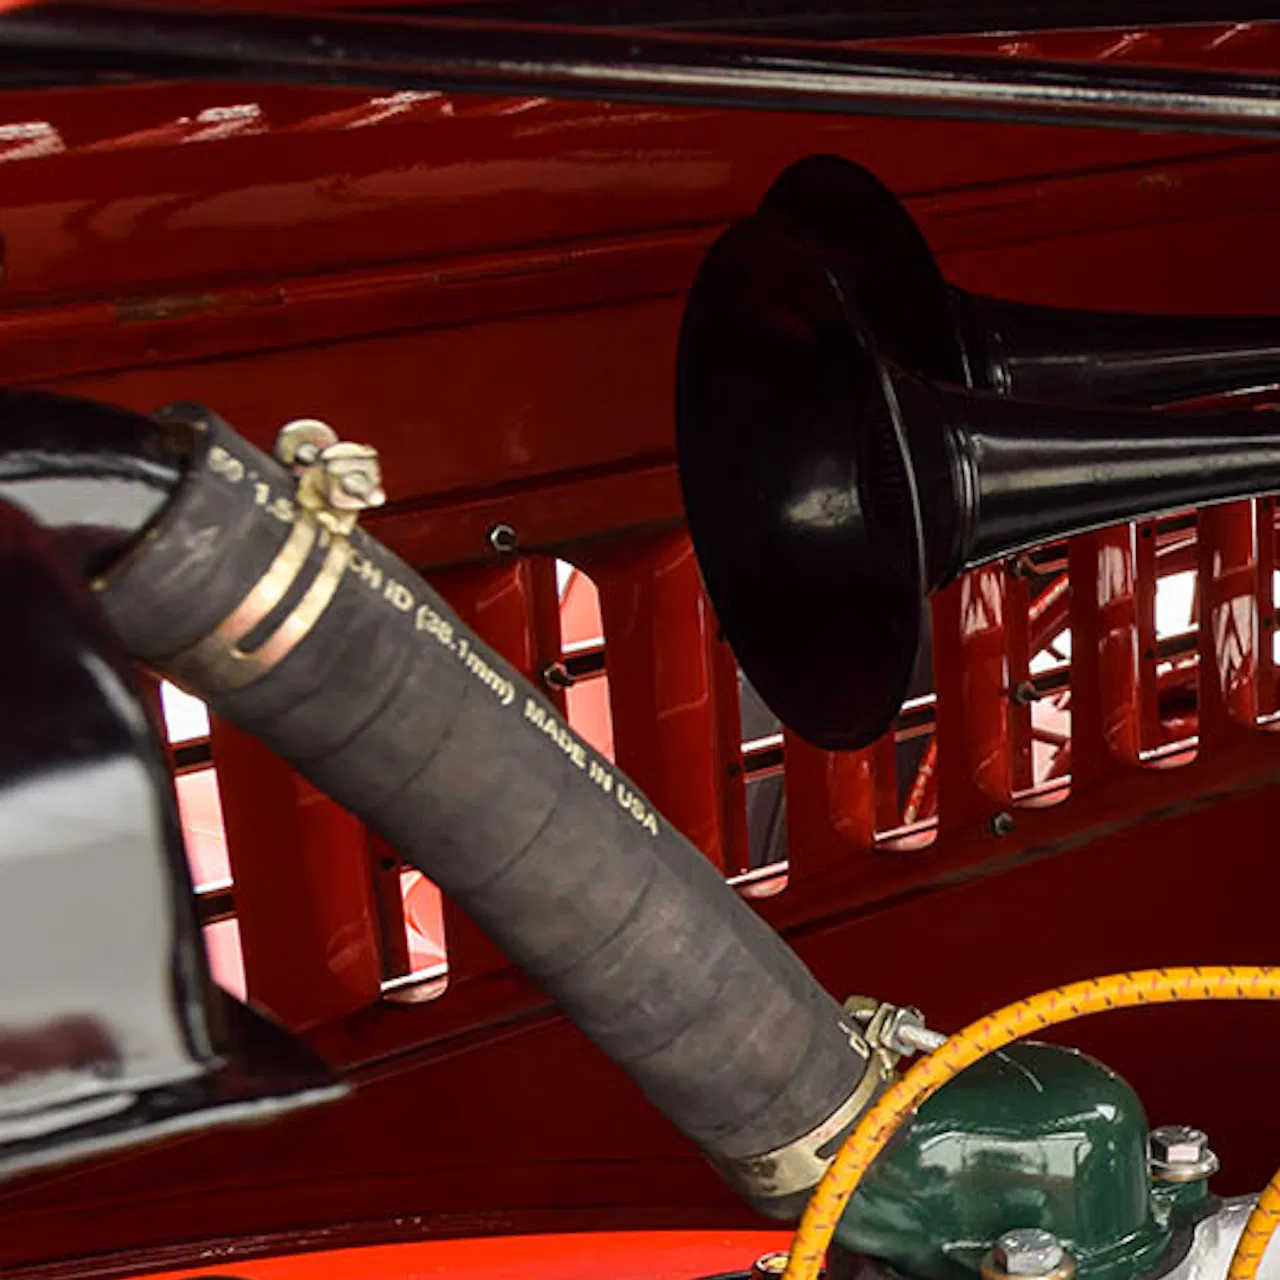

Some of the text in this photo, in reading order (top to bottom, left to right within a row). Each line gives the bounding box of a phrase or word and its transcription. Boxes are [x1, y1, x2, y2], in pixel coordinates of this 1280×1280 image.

[383, 577, 414, 612] ID
[415, 603, 515, 706] (38.1mm)
[524, 697, 586, 769] MADE
[589, 760, 613, 792] IN
[616, 783, 659, 836] USA
